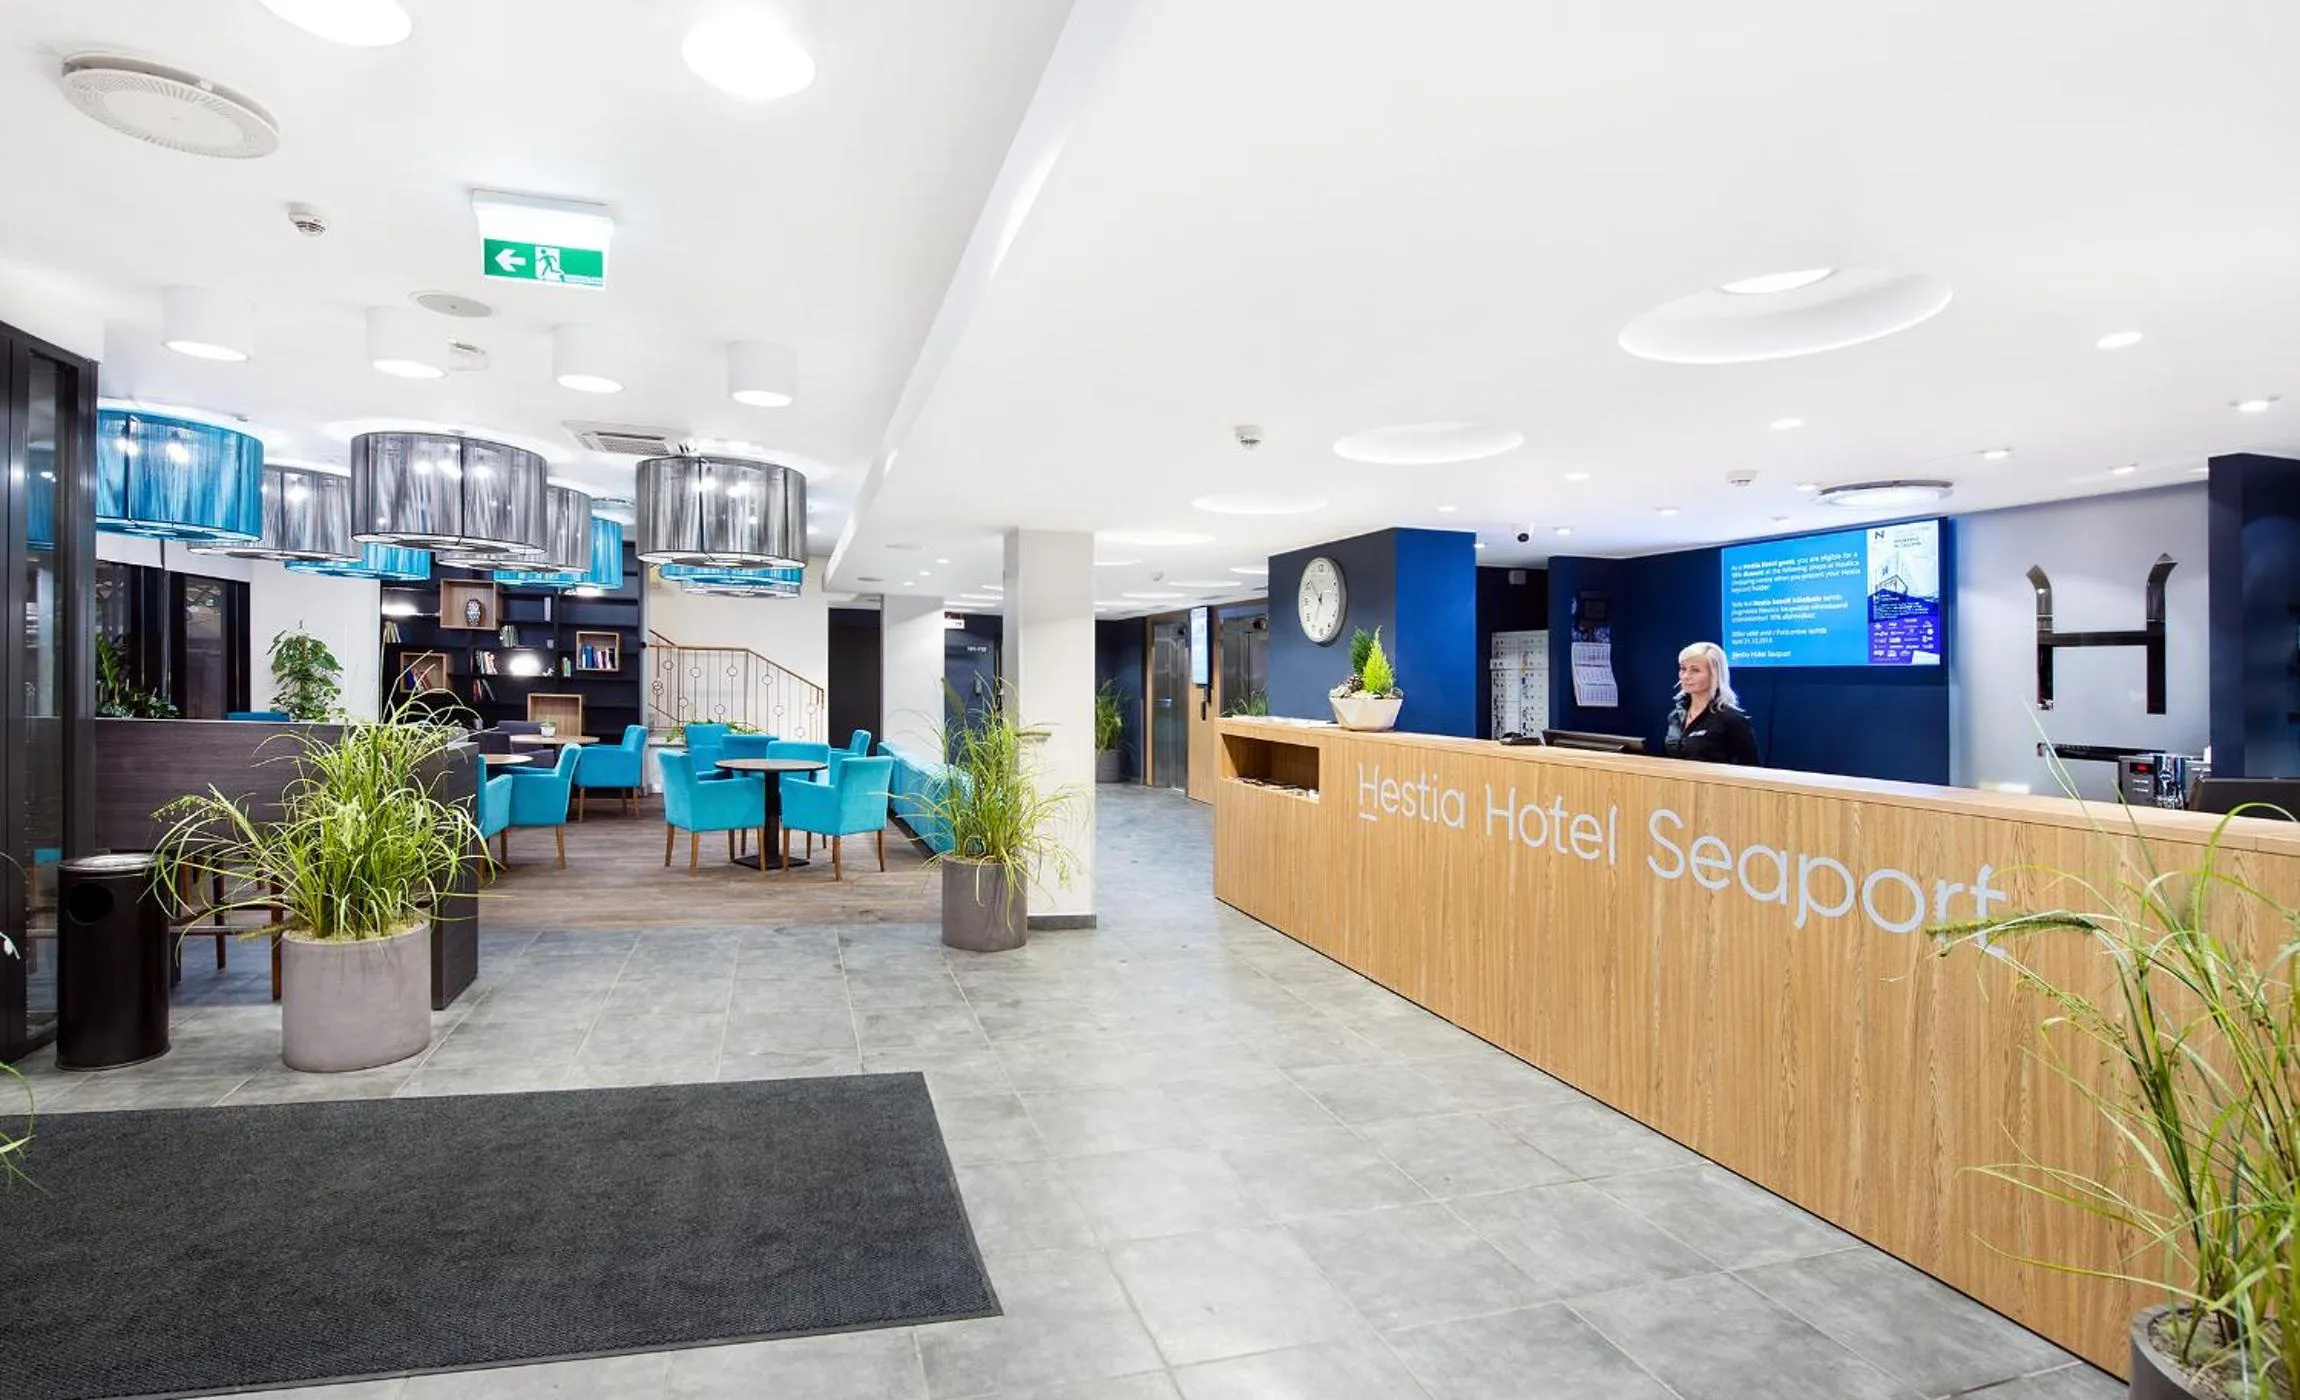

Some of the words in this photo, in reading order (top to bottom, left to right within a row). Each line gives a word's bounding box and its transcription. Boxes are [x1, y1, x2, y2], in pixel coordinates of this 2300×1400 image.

[1358, 762, 1466, 829] Hestia
[1485, 782, 1618, 866] Hotel
[1646, 808, 2010, 958] Seaport
